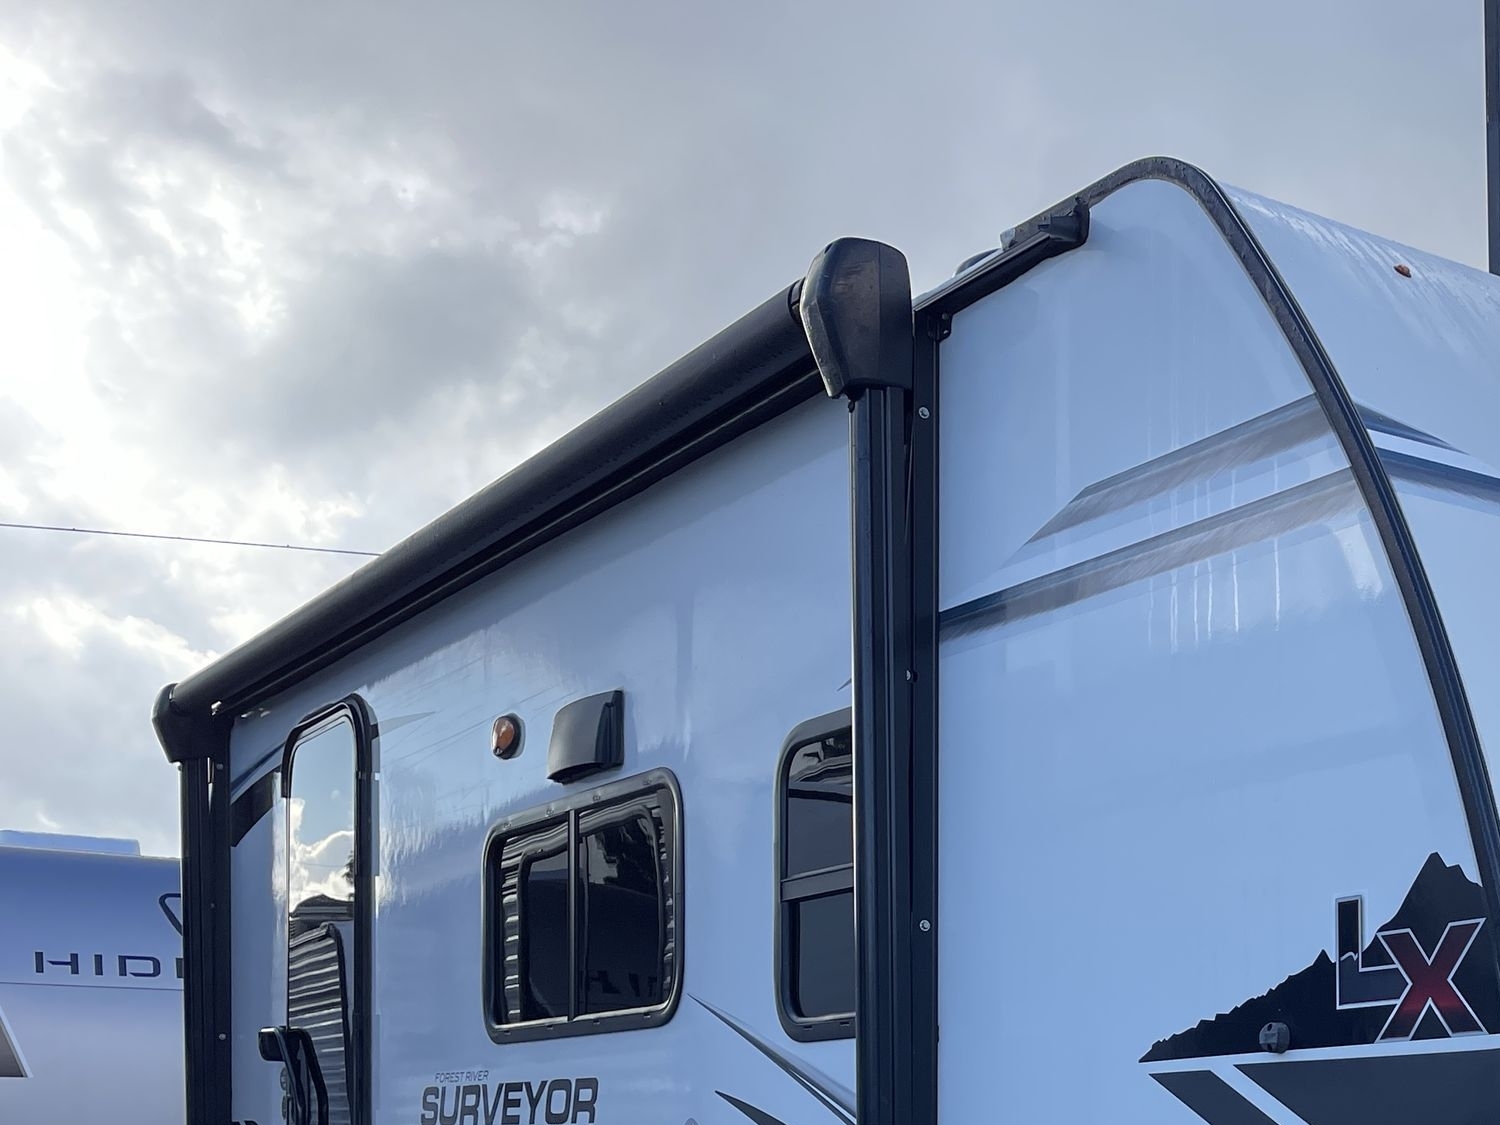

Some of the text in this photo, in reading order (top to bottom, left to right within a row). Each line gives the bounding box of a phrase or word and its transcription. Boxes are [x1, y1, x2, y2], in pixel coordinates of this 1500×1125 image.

[1335, 894, 1490, 1045] LX
[435, 1070, 490, 1084] FOREST RIVER
